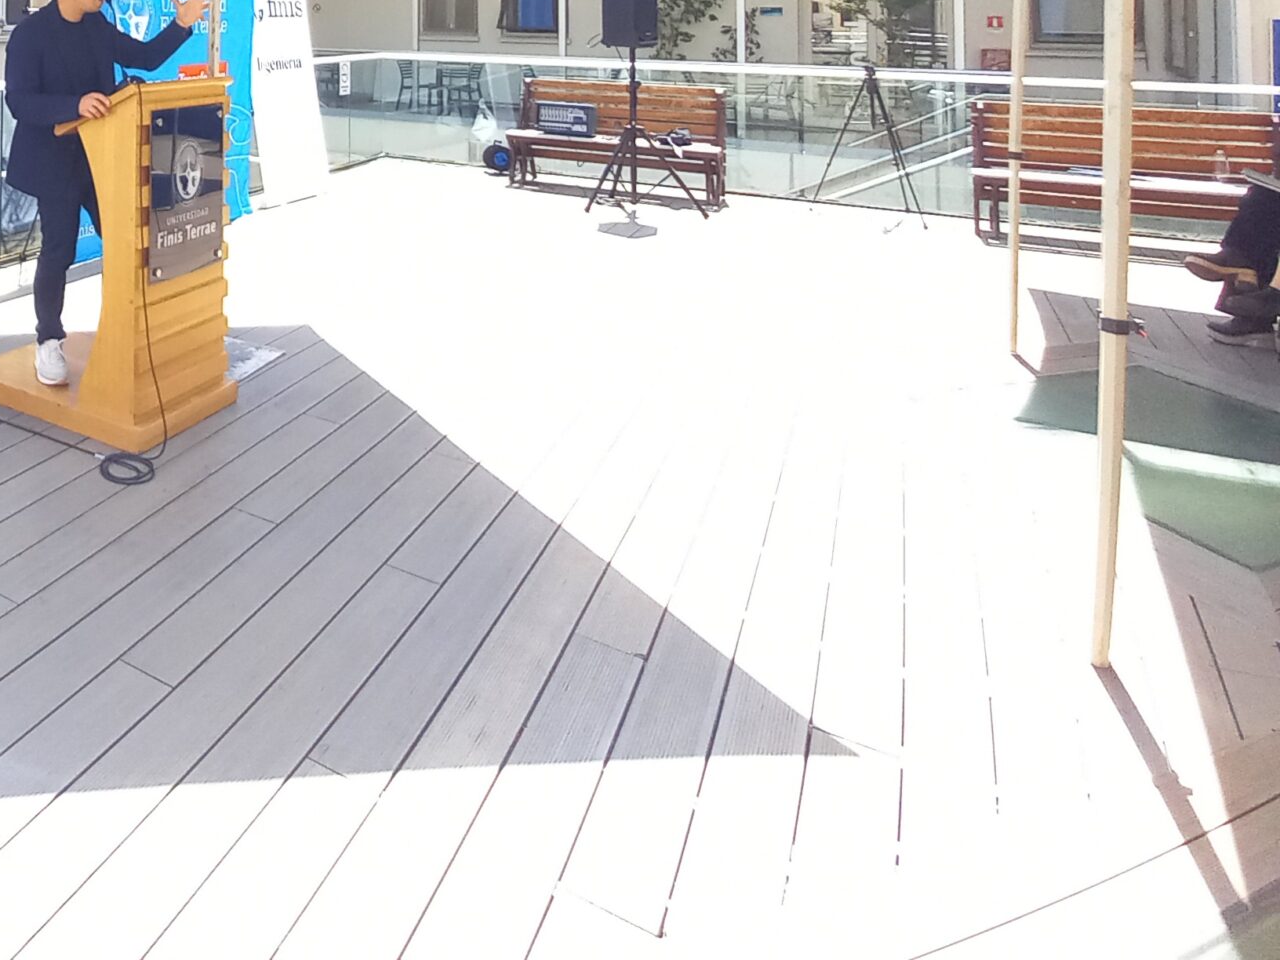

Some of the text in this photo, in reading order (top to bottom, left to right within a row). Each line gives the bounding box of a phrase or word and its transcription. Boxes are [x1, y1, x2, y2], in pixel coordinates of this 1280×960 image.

[166, 206, 210, 226] UNIVERSIDAD
[157, 221, 217, 250] Finis Terrae
